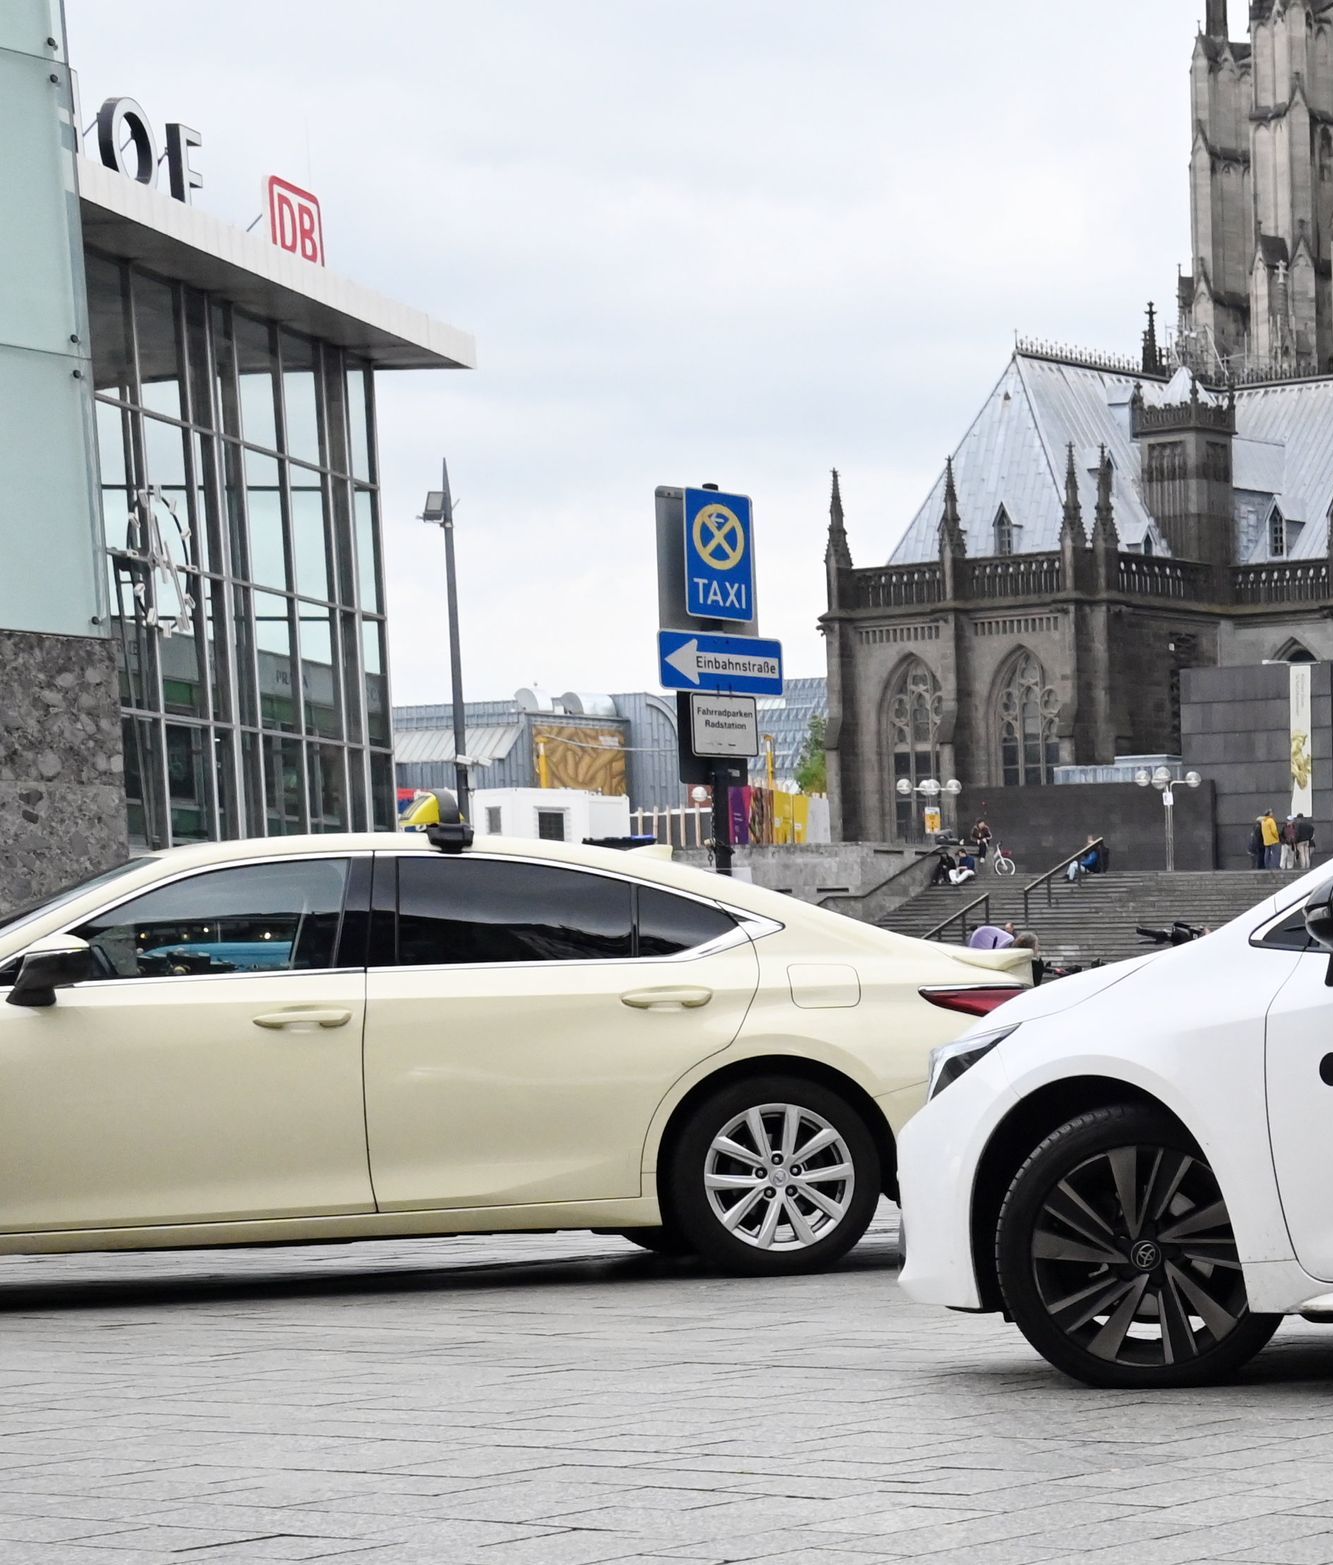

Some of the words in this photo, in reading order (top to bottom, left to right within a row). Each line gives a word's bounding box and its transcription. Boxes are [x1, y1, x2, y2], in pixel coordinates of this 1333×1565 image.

[70, 66, 203, 206] OF
[276, 192, 318, 263] DB
[693, 577, 747, 609] TAXI
[695, 655, 777, 675] Einbahnstraße
[697, 706, 753, 719] Fahrradparken
[704, 719, 747, 730] Radstation
